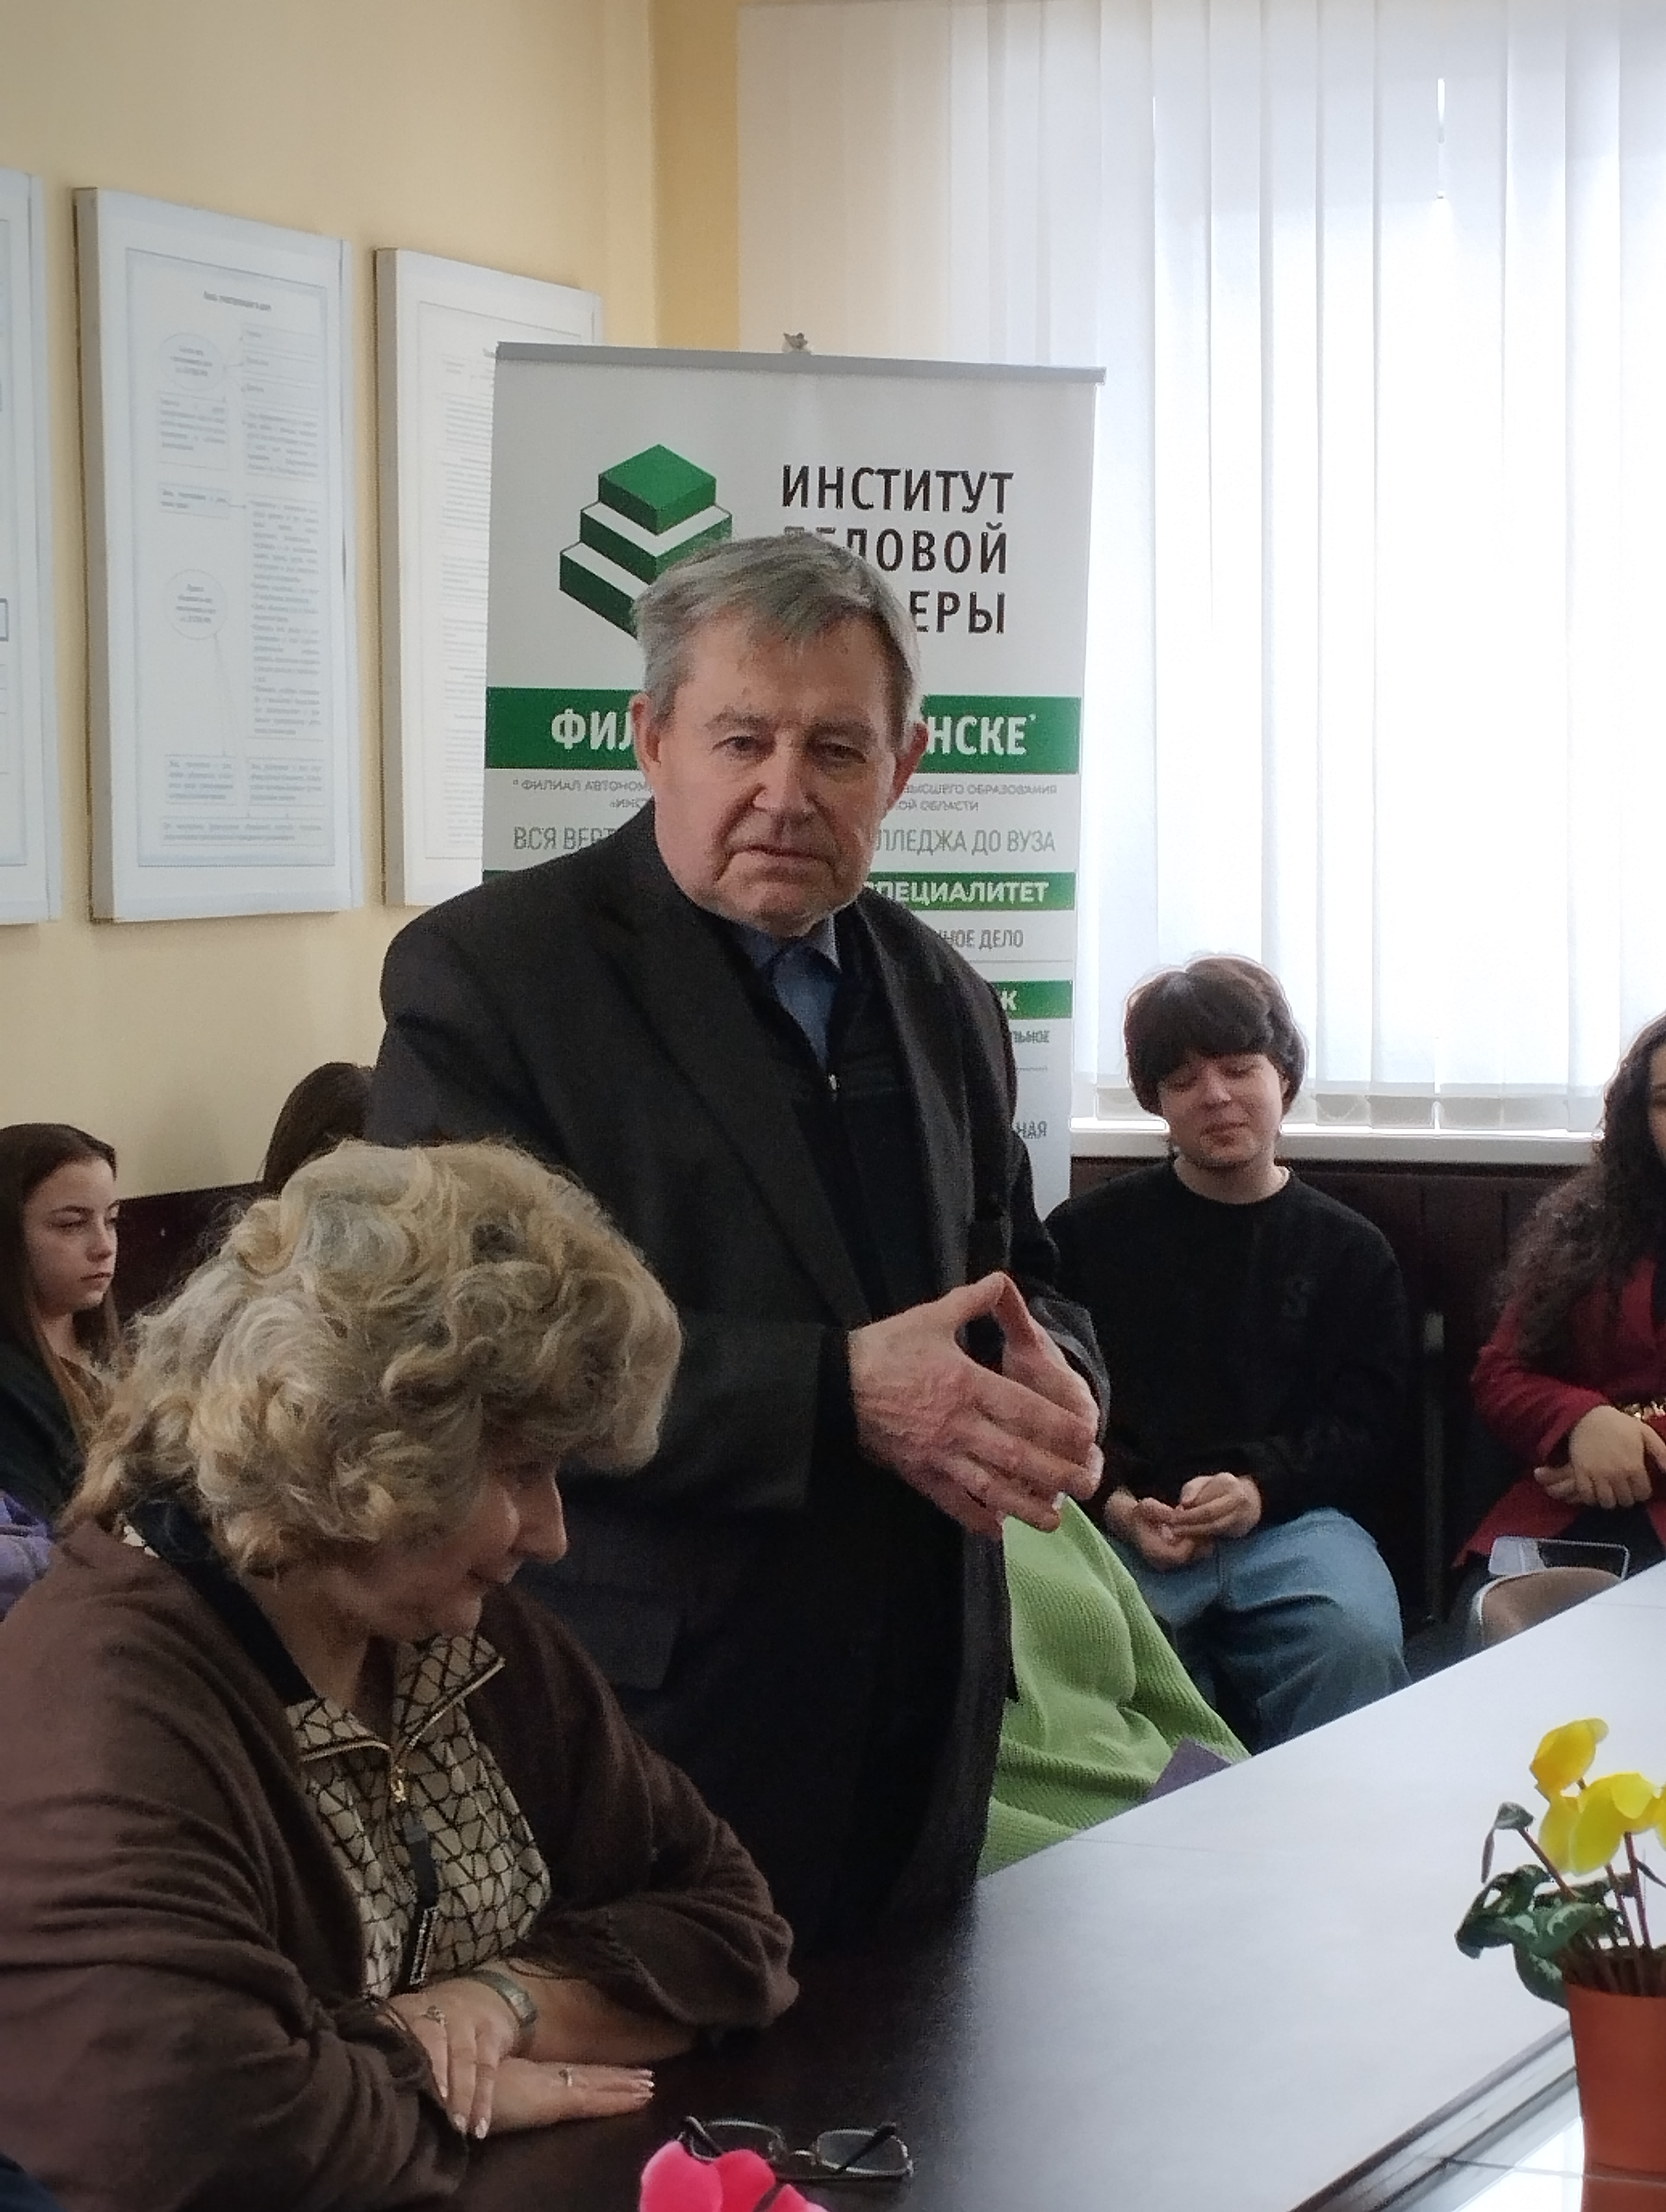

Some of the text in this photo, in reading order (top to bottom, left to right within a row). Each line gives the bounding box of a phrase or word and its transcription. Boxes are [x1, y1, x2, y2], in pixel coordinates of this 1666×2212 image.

[781, 464, 1014, 514] ИНСТИТУТ
[784, 522, 1007, 575] ЛОВОЙ
[910, 590, 1006, 634] ЕРЫ
[551, 708, 1036, 755] ФИЛ НСКЕ
[521, 779, 581, 792] ФИЛИАЛ
[584, 781, 648, 792] АВТОНОМ
[967, 784, 1058, 795] ОБРАЗОВАНИЯ
[920, 800, 979, 812] ОБЛАСТИ
[514, 826, 557, 850] ВСЯ
[876, 829, 967, 856] ЛЛЕДЖА
[971, 829, 1002, 856] ДО
[1007, 830, 1056, 853] ВУЗА
[978, 929, 1024, 950] ДЕЛО
[999, 990, 1017, 1011] К
[1016, 1121, 1048, 1139] НАЯ
